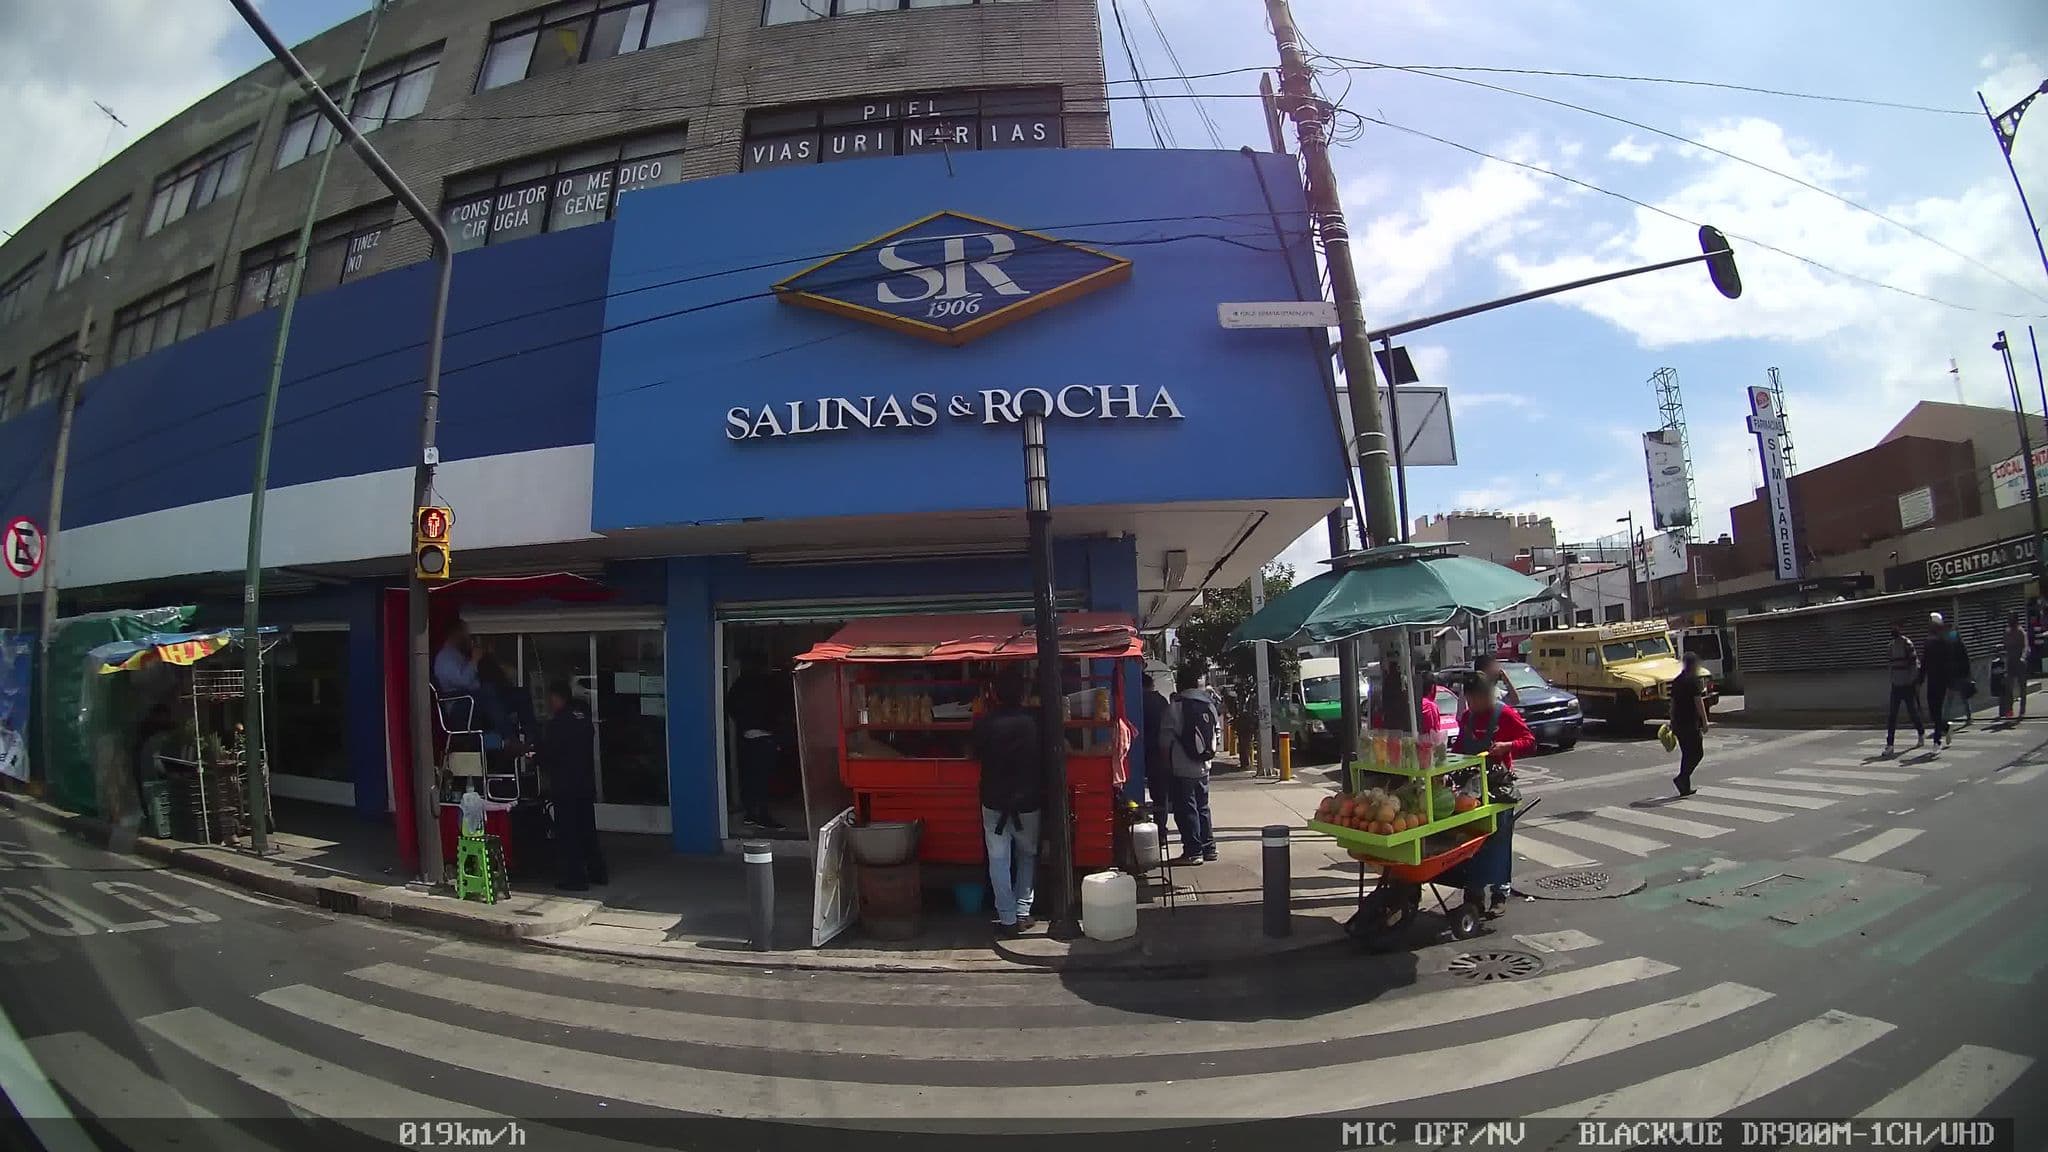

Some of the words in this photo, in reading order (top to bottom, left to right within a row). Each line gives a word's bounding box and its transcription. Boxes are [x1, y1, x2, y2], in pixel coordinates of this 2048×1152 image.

[863, 99, 941, 121] PIEL
[753, 141, 810, 163] VIAS
[587, 161, 662, 191] MEDICO
[462, 209, 530, 240] CIRUGIA
[877, 232, 1030, 303] SR
[926, 297, 981, 318] 1906
[725, 391, 938, 440] SALINAS
[948, 395, 975, 417] &
[979, 384, 1186, 425] ROCHA
[1767, 437, 1793, 571] SIMILARES
